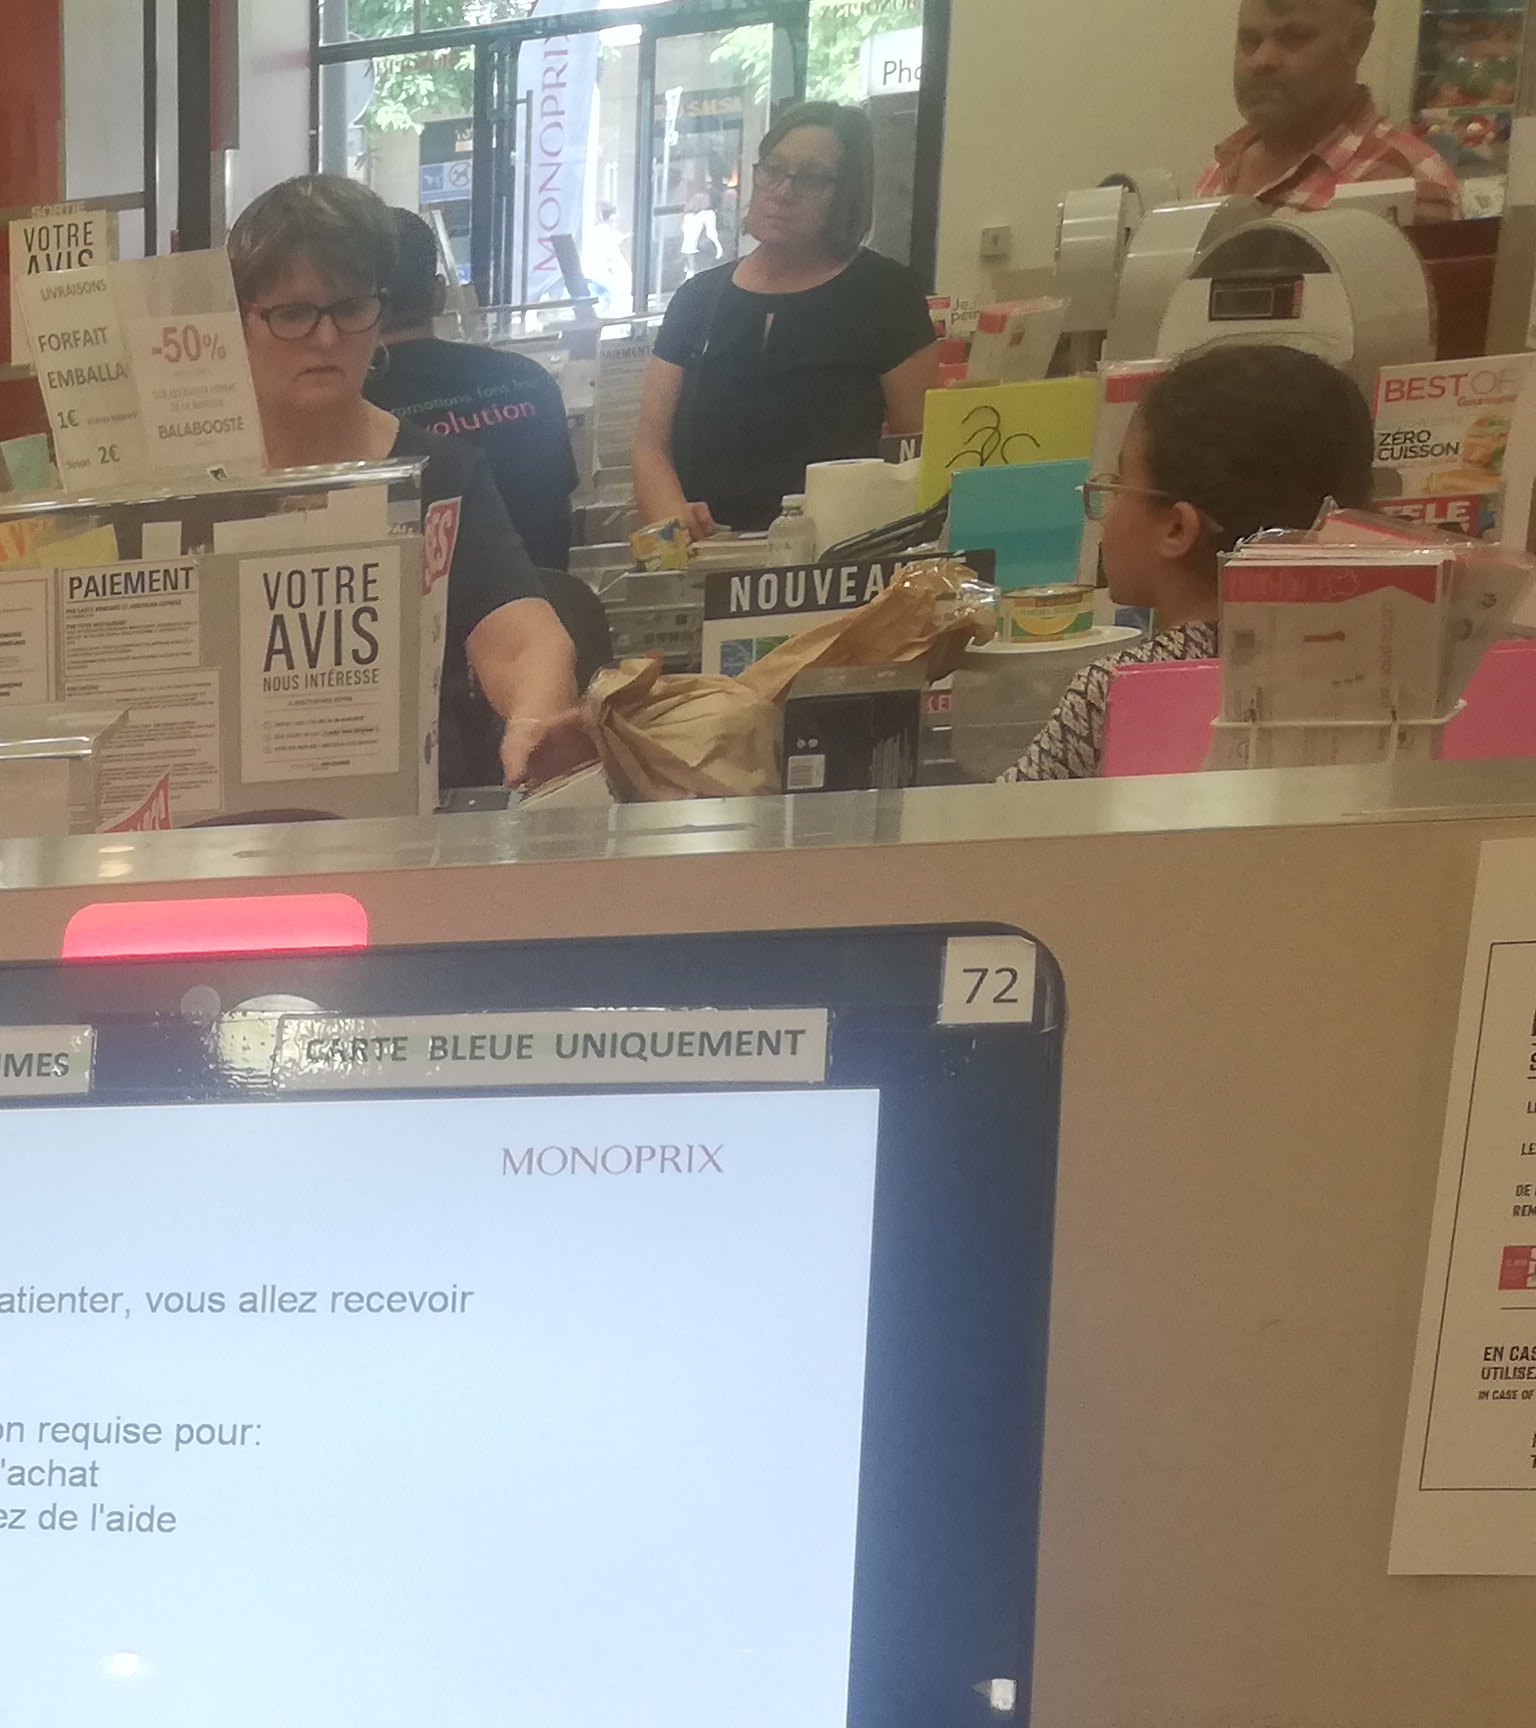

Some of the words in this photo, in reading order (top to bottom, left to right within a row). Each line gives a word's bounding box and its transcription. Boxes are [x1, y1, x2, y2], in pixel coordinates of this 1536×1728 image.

[23, 221, 94, 254] VOTRE
[40, 278, 108, 301] LIVRAISONS
[38, 326, 109, 353] FORFAIT
[151, 324, 227, 364] -50%
[47, 362, 127, 389] EMBALLA
[1384, 373, 1469, 403] BEST
[56, 409, 80, 429] 1€
[1378, 426, 1431, 447] ZÉRO
[1378, 441, 1460, 461] CUISSON
[97, 444, 121, 465] 2€
[68, 565, 195, 600] PAIEMENT
[263, 562, 380, 611] VOTRE
[263, 606, 380, 673] AVIS
[263, 674, 300, 693] NOUS
[305, 667, 380, 688] INTÉRESSE
[961, 966, 1020, 1005] 72
[306, 1036, 409, 1062] CARTE
[428, 1032, 535, 1062] BLEUE
[554, 1028, 808, 1063] UNIQUEMENT
[502, 1144, 725, 1178] MONOPRIX
[145, 1290, 227, 1315] vous
[238, 1284, 318, 1315] allez
[330, 1283, 475, 1315] recevoir
[37, 1416, 163, 1454] requise
[174, 1421, 263, 1452] pour:
[37, 1502, 78, 1533] de
[89, 1502, 177, 1535] l'aide
